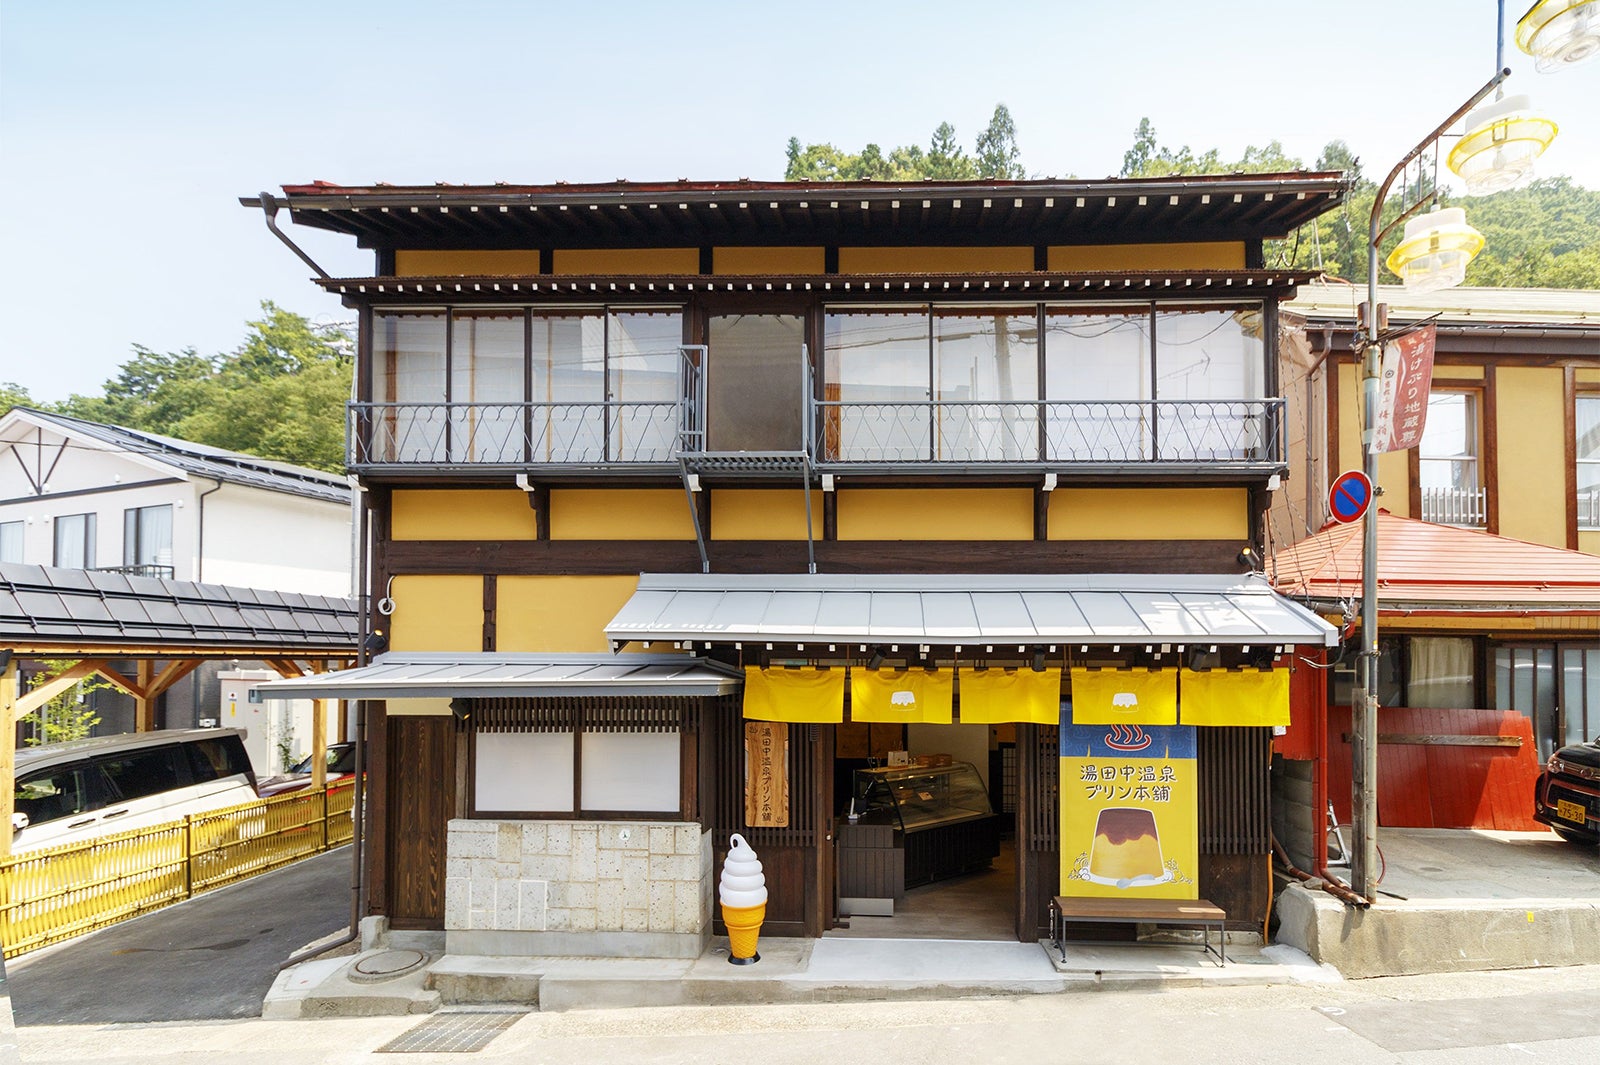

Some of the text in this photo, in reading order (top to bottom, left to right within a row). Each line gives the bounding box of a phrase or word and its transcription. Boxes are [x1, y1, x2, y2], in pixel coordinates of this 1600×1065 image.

[761, 728, 772, 822] 湯田中温泉プリン本舗
[1080, 765, 1177, 782] 湯田中温泉
[1085, 785, 1171, 802] プリン本舗
[1563, 807, 1583, 822] 75-30
